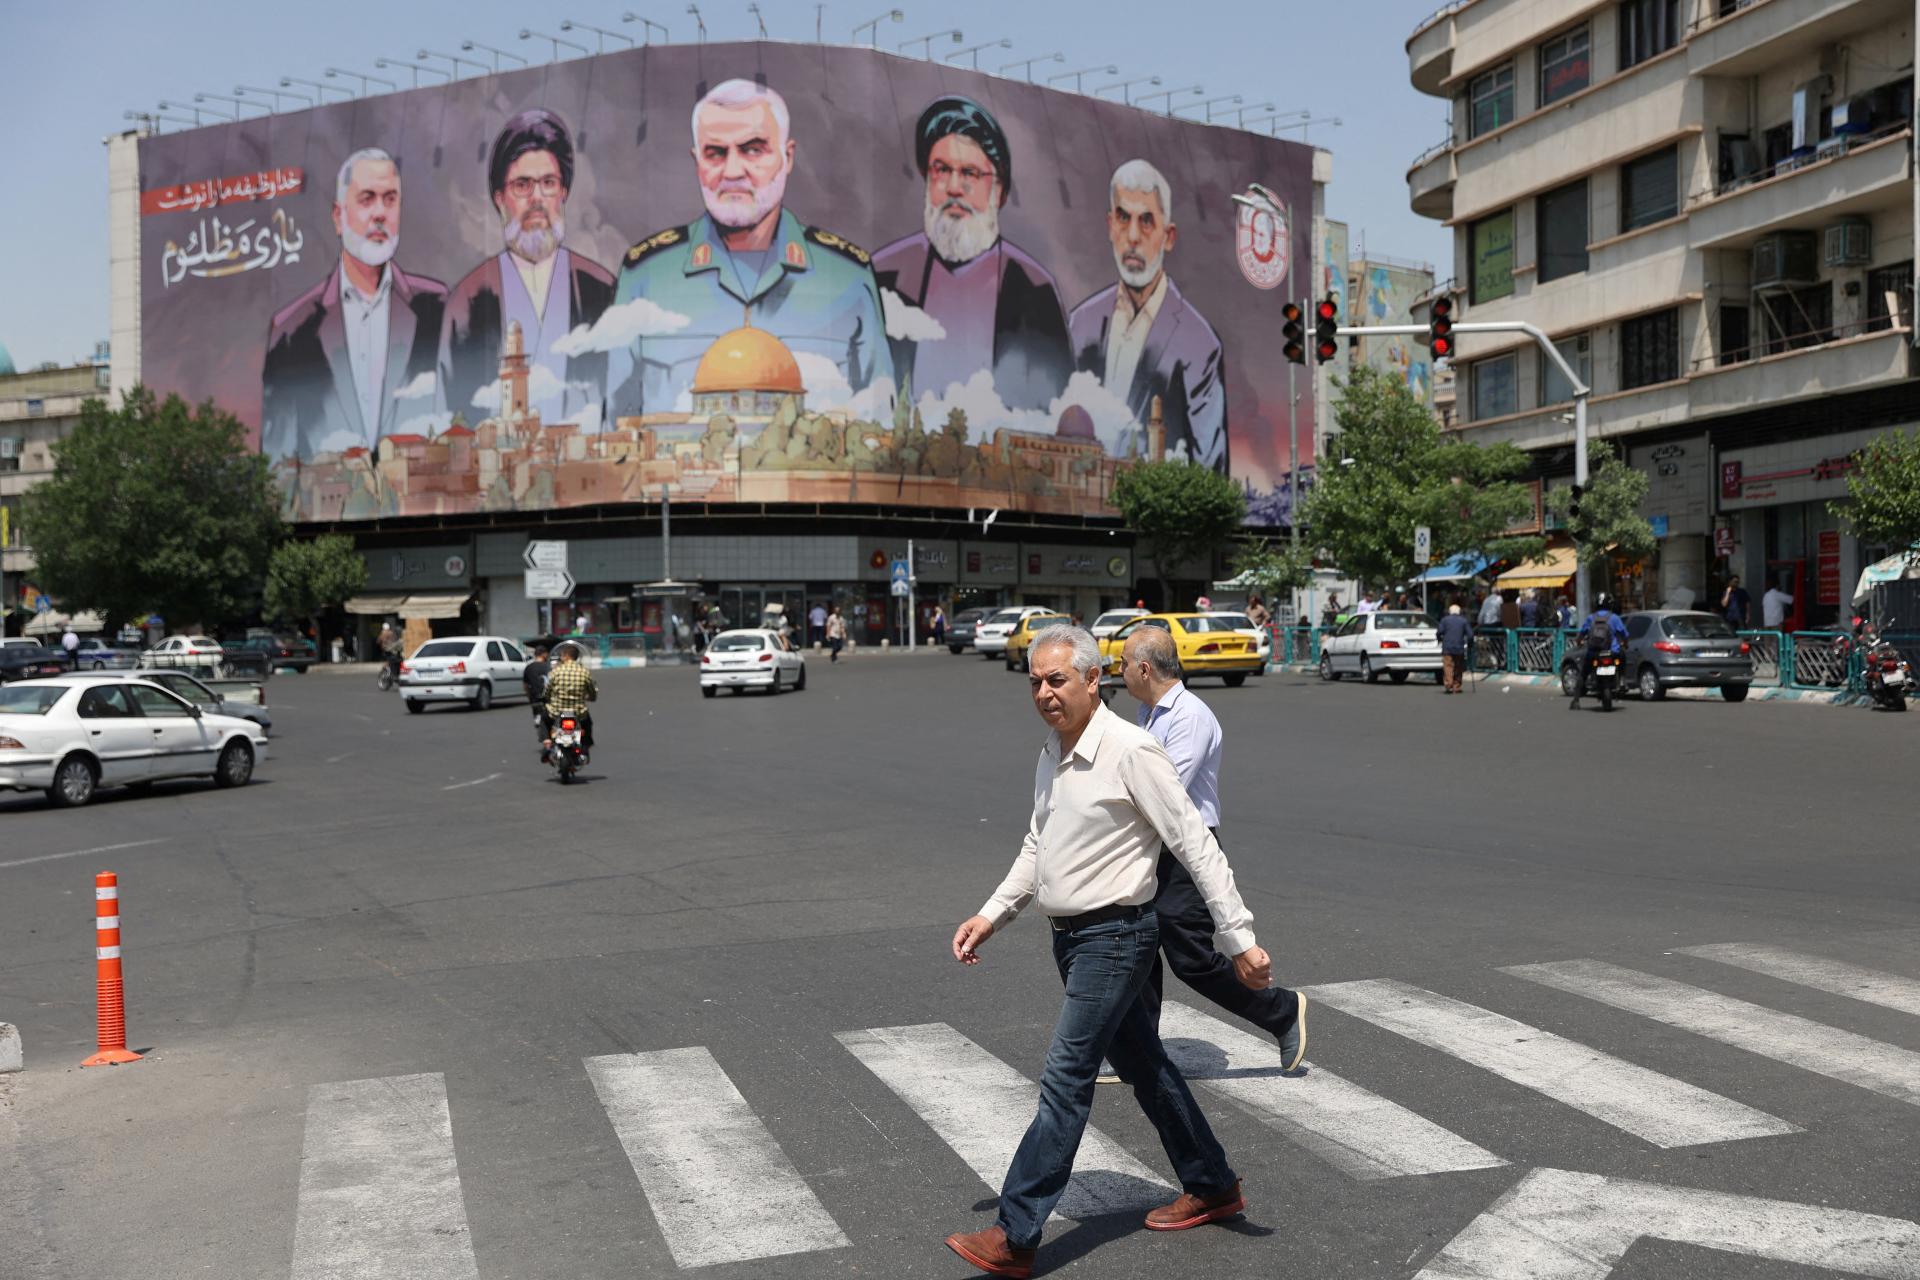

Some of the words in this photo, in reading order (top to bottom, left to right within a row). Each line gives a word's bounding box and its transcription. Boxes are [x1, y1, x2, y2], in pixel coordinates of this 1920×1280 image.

[233, 172, 276, 199] وظیفه
[277, 168, 301, 191] خدا
[158, 183, 208, 212] نوشت
